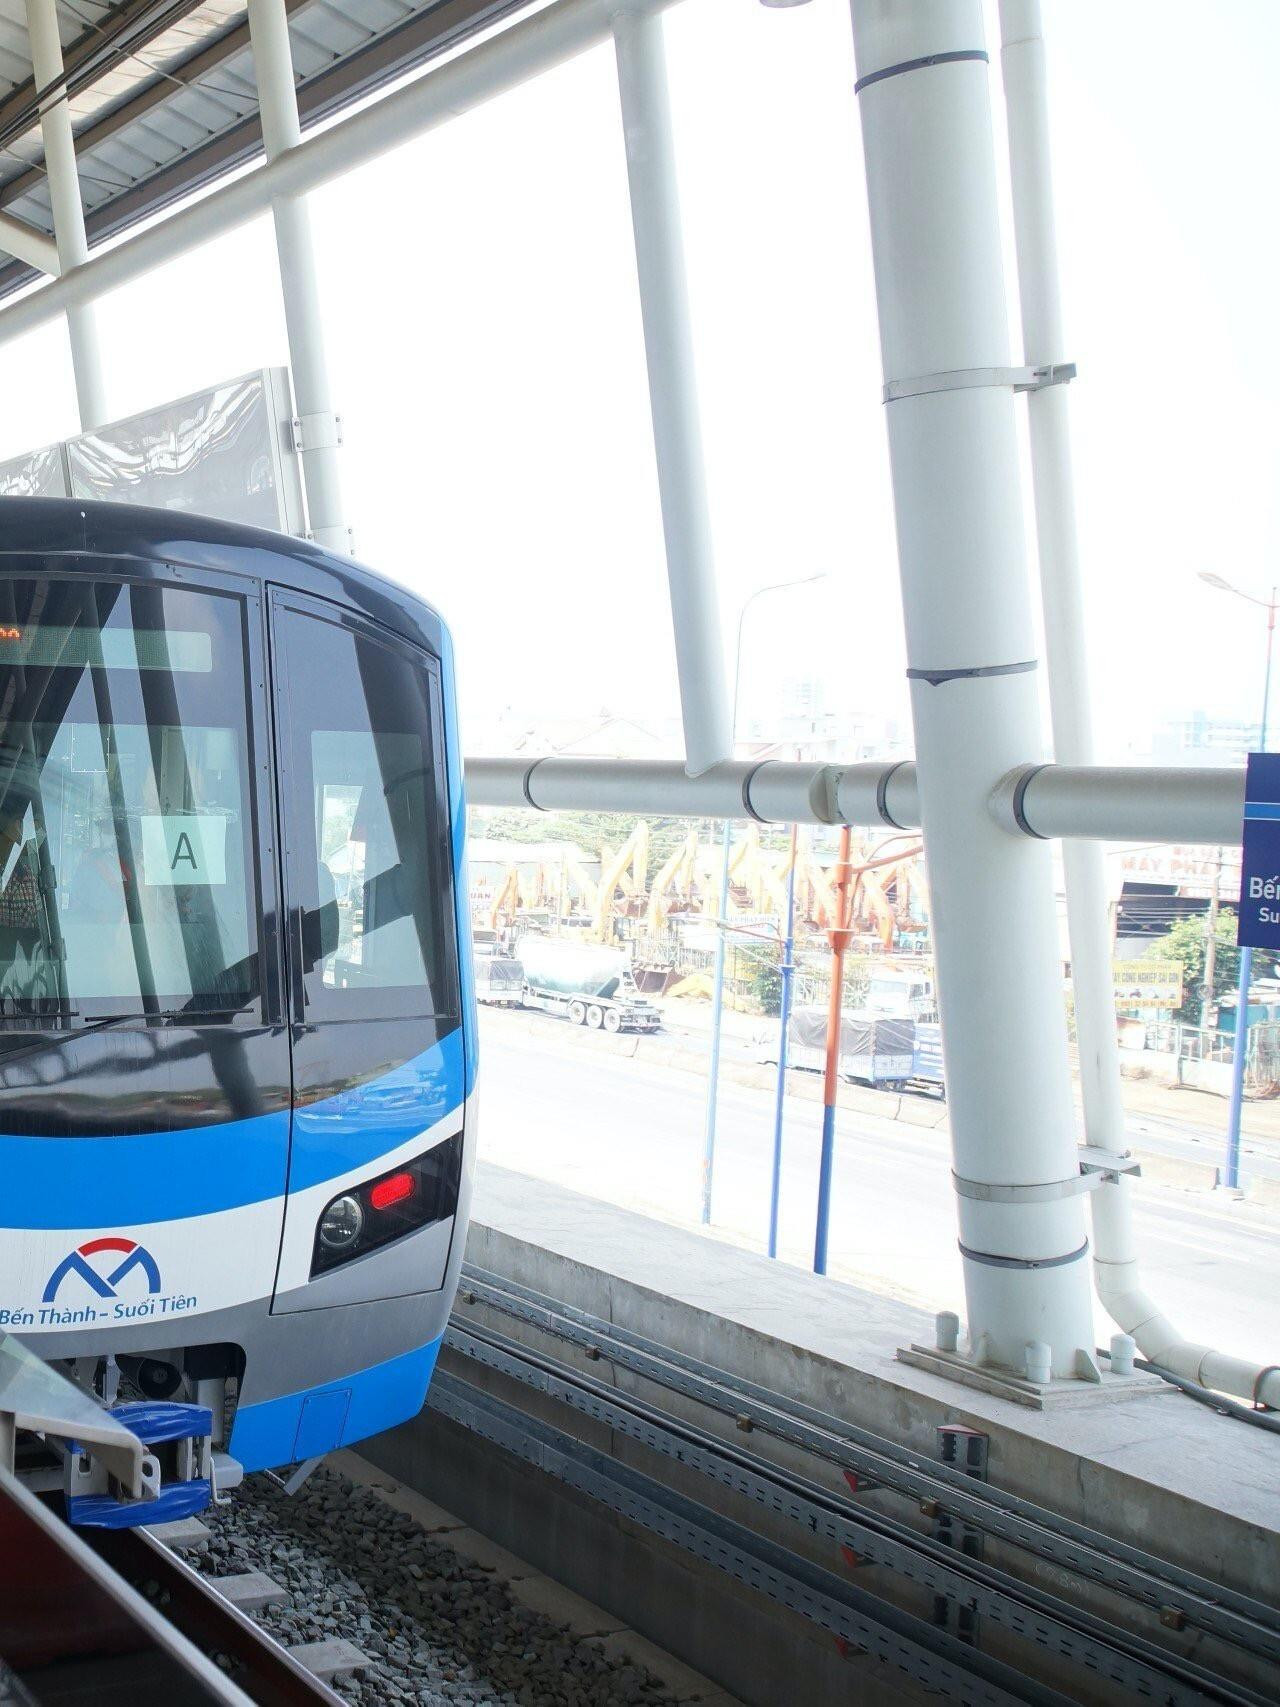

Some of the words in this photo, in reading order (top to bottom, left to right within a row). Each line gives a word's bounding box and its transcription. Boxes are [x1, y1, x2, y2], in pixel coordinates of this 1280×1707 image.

[170, 831, 198, 870] A
[38, 1305, 97, 1324] Thành
[113, 1298, 155, 1319] Suối
[158, 1294, 198, 1313] Tiên
